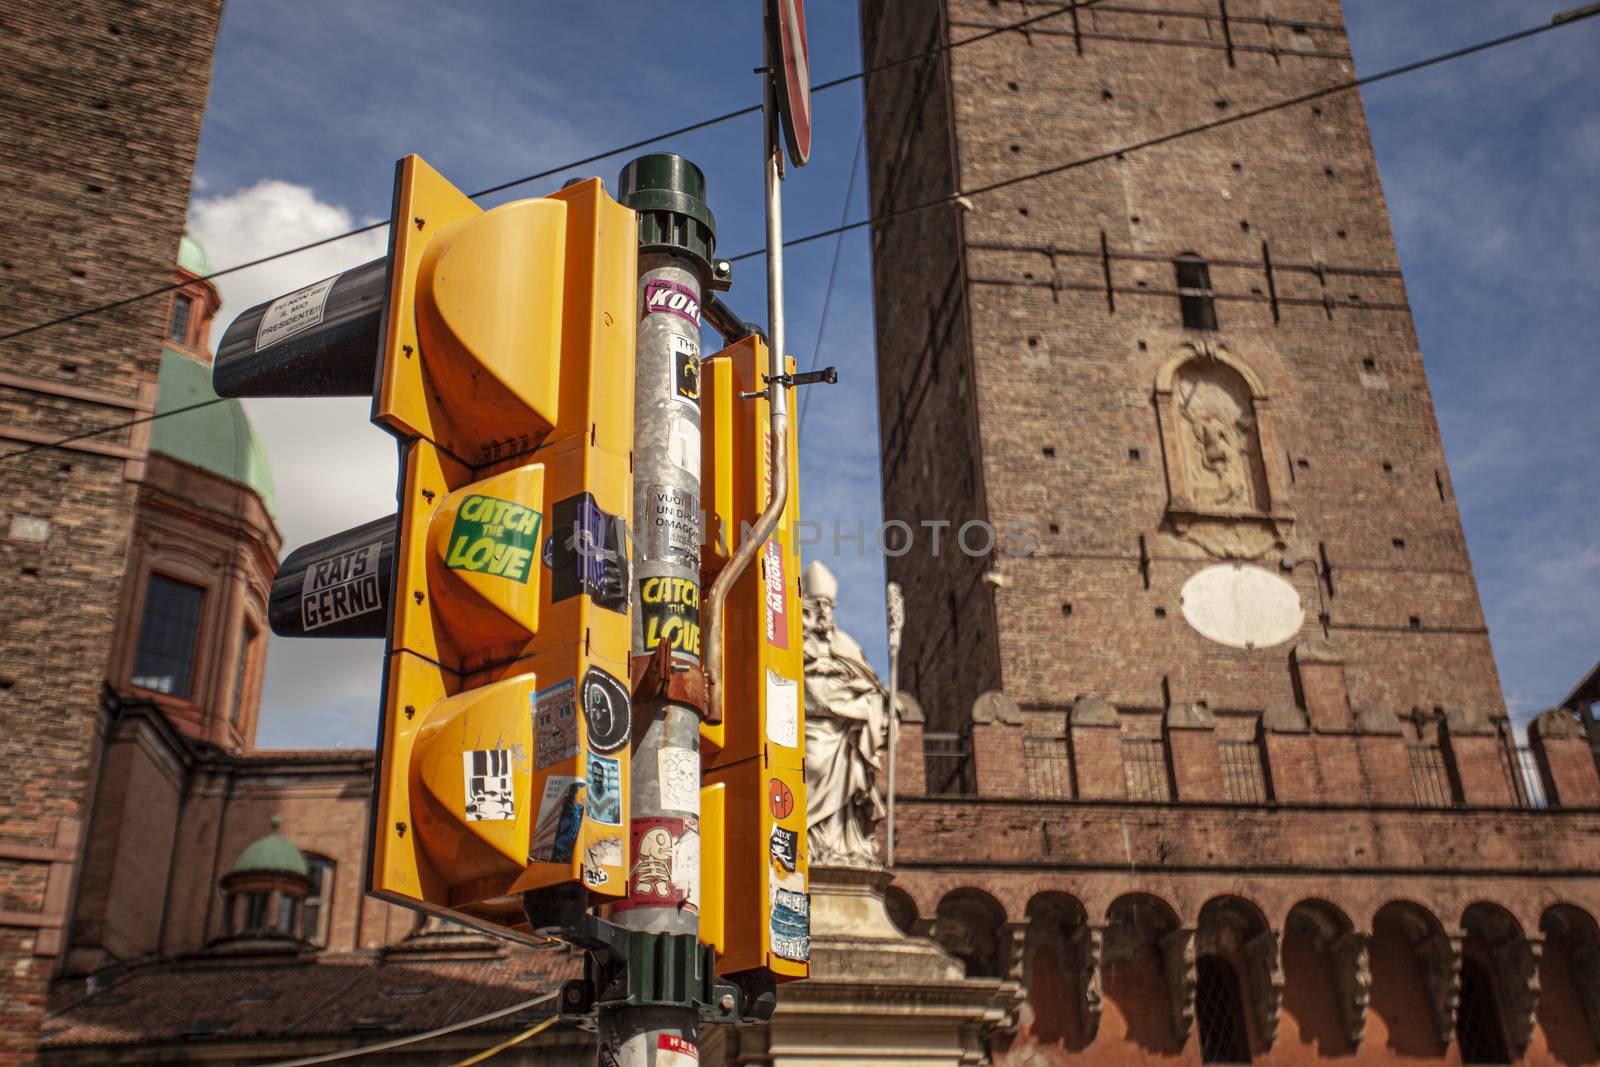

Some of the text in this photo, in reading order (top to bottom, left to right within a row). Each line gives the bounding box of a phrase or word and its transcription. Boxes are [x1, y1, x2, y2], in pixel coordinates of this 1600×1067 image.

[291, 301, 308, 313] MIO
[460, 496, 539, 535] CATCH
[656, 506, 673, 515] UN
[482, 524, 505, 538] THE
[447, 535, 531, 579] LOVE
[643, 577, 699, 610] CATCH
[647, 615, 700, 656] LOVE
